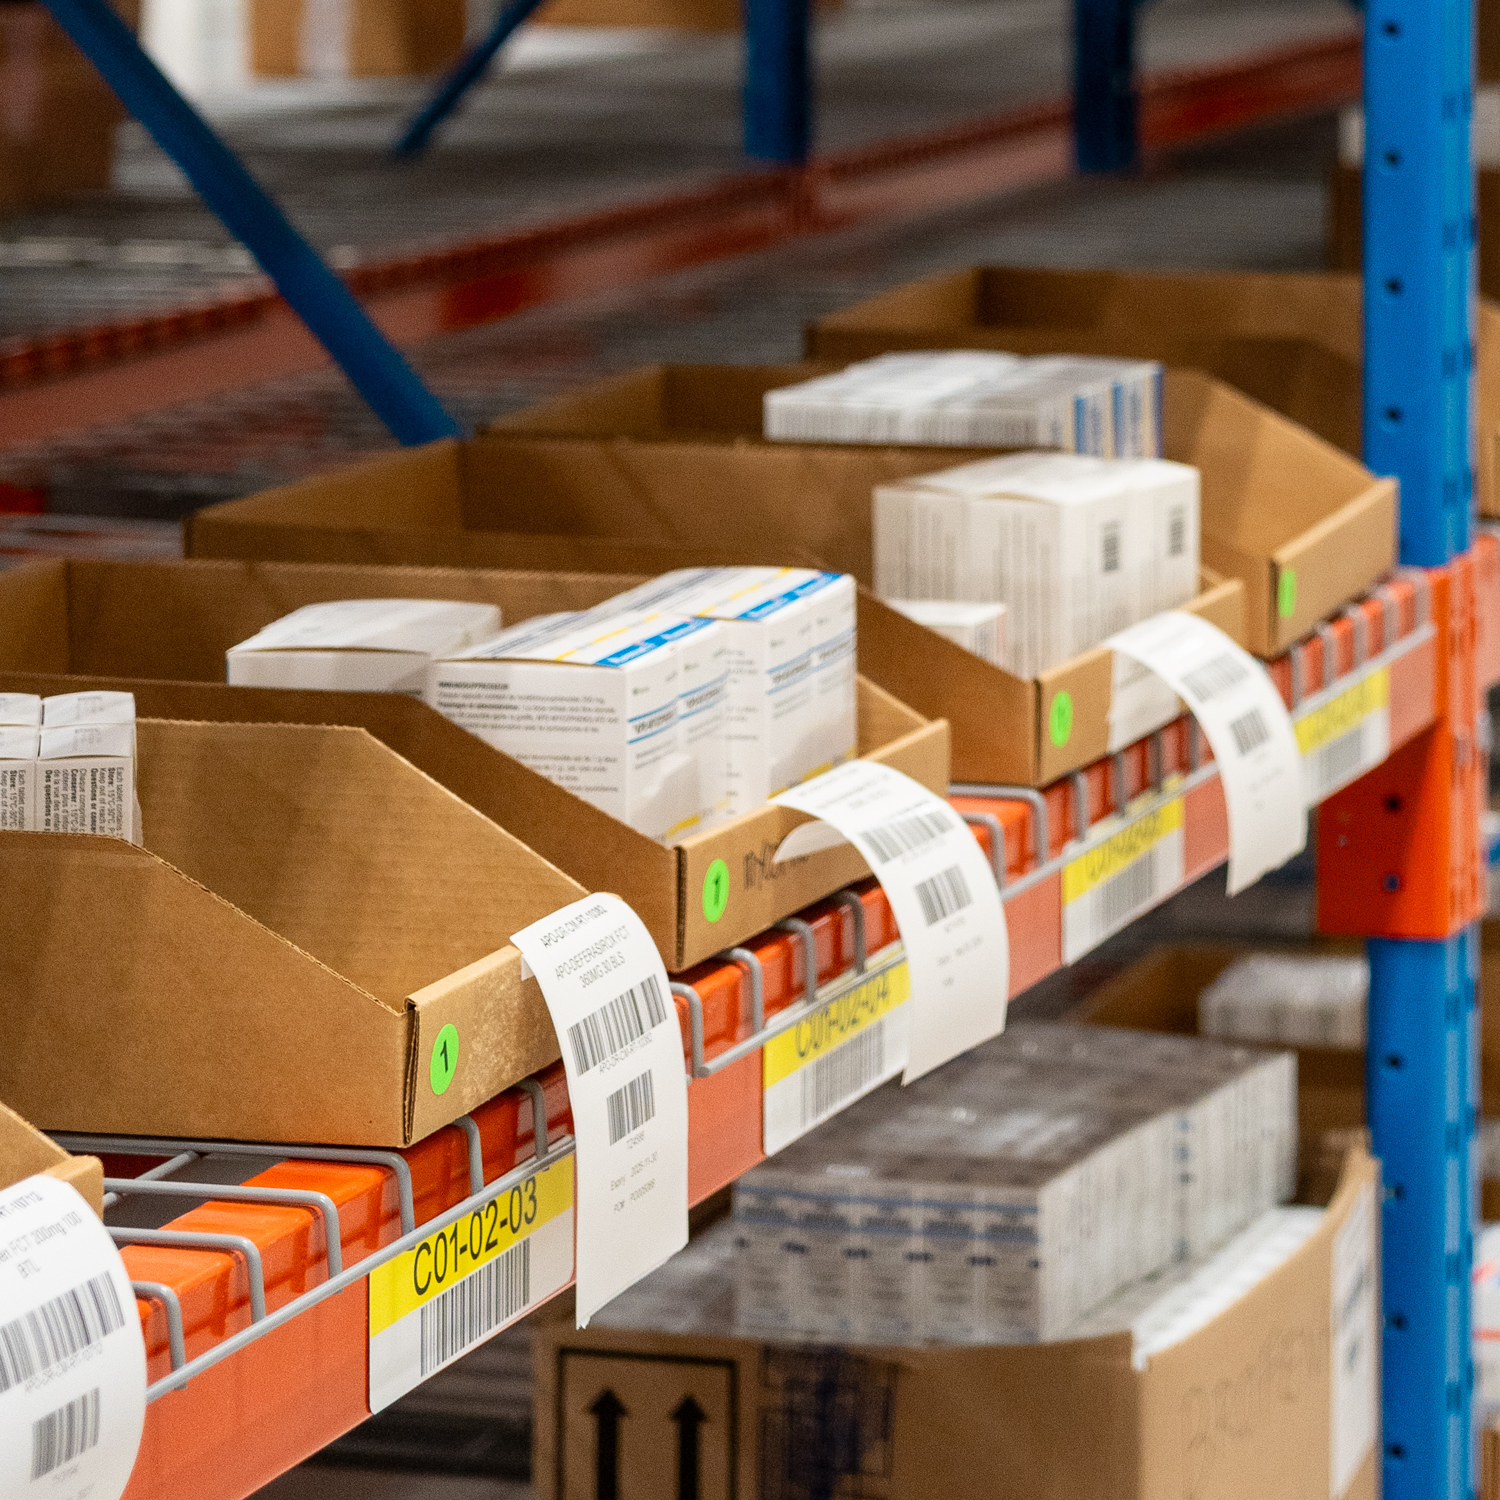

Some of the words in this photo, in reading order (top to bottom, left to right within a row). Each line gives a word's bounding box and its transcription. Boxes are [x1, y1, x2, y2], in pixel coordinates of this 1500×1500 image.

[45, 769, 53, 783] Des
[90, 768, 98, 801] Questions
[116, 766, 124, 783] Each
[44, 784, 53, 816] questions
[116, 784, 124, 802] tablet
[554, 933, 617, 980] APO-DEFERASIROX
[439, 1039, 449, 1073] 1
[30, 1222, 67, 1245] 200mg
[413, 1175, 538, 1296] C01-02-03
